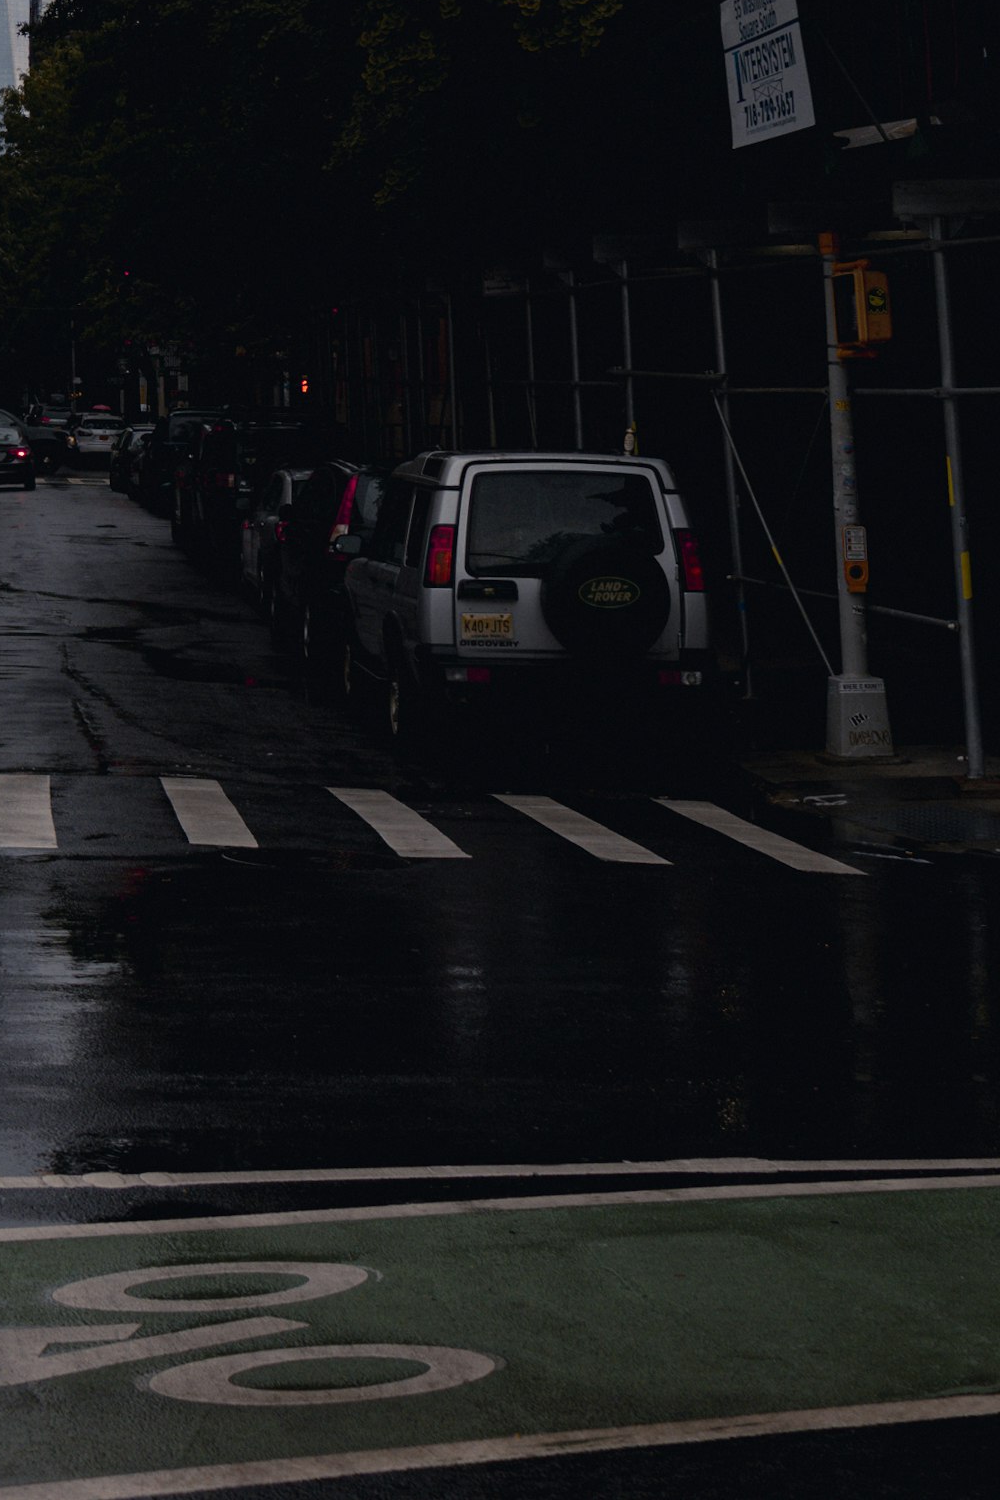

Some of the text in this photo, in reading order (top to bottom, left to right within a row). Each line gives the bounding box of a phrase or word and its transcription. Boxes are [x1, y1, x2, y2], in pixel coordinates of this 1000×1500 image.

[739, 4, 777, 41] Square South
[732, 32, 796, 103] INTERSYSTEM
[591, 582, 621, 592] LAND
[594, 591, 632, 601] ROVER
[459, 639, 519, 647] DISCOVERY
